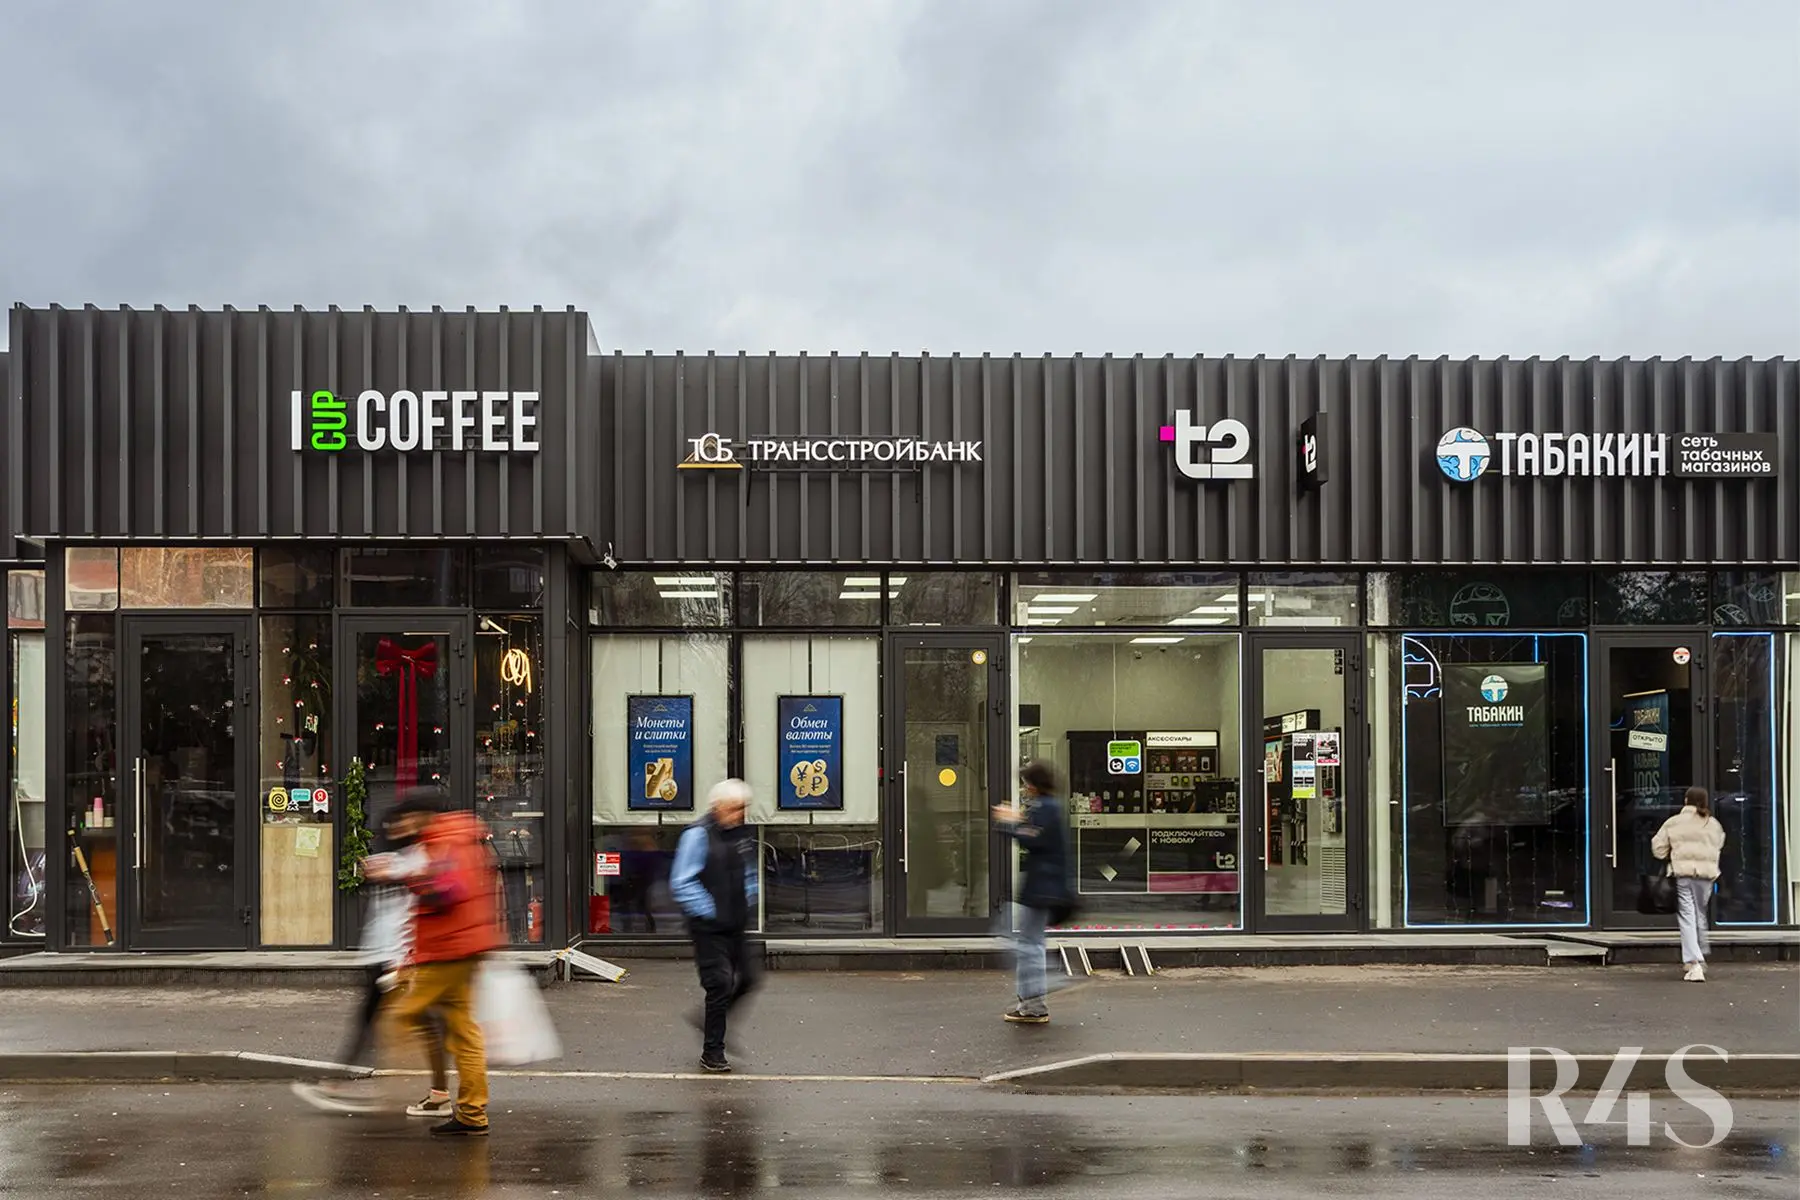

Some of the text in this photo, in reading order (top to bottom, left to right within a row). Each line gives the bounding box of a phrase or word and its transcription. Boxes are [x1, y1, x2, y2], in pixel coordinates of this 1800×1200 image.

[291, 389, 540, 451] I CUP COFFEE
[1160, 409, 1254, 479] t2
[1680, 436, 1719, 448] сеть
[747, 437, 983, 462] ТРАНССТРОЙБАНК
[1495, 432, 1667, 477] ТАБАКИН
[1680, 448, 1764, 461] табачных
[1681, 461, 1772, 473] магазинов
[1466, 705, 1524, 722] ТАБАКИН
[636, 716, 685, 729] Монеты
[790, 716, 828, 729] Обмен
[634, 731, 687, 740] и слитки
[785, 731, 833, 740] валюты
[1634, 770, 1661, 797] IQOS
[1151, 830, 1226, 838] ПОДКЛЮЧАЙТЕСЬ
[1213, 851, 1236, 869] t2
